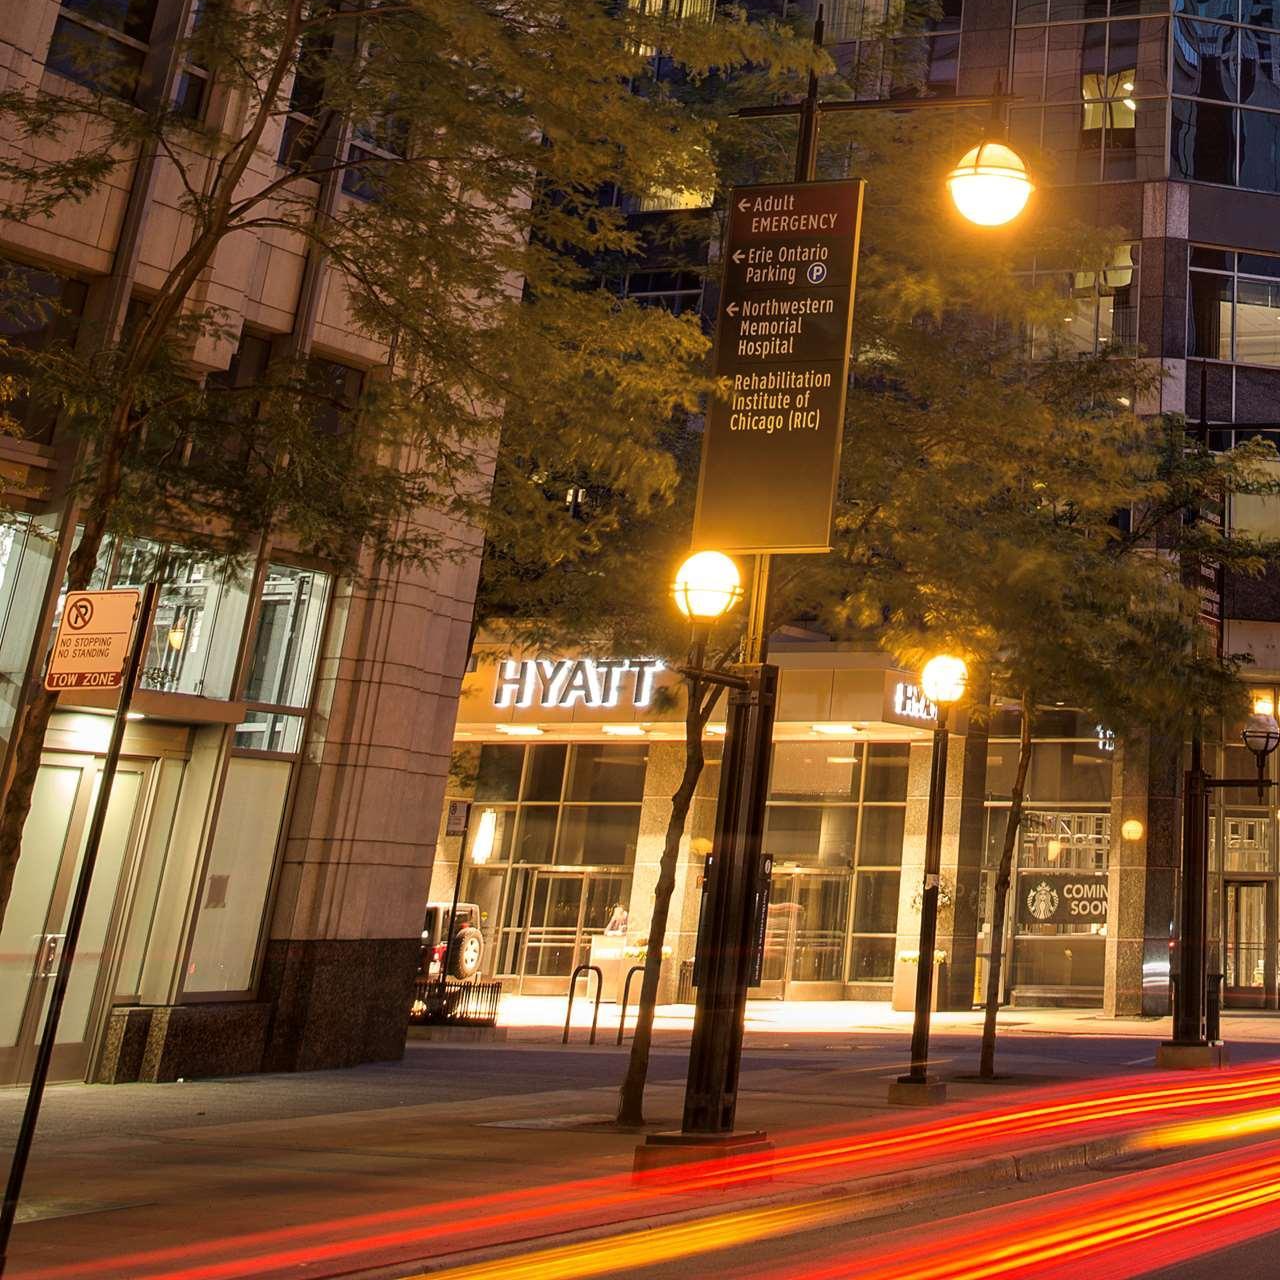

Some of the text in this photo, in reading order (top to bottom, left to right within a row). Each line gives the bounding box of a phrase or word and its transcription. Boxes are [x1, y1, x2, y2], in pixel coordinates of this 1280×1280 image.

[753, 195, 795, 213] Adult
[751, 213, 838, 233] EMERGENCY
[748, 243, 828, 264] Erie Ontario
[746, 264, 796, 285] Parking
[742, 297, 834, 317] Northwestern
[740, 317, 802, 336] Memorial
[738, 337, 794, 359] Hospital
[734, 370, 832, 391] Rehabilitation
[732, 390, 811, 411] Institute of
[730, 409, 820, 434] Chicago (RIC)
[60, 636, 112, 648] NO STOPPING
[57, 648, 110, 658] NO STANDING
[52, 672, 116, 687] TOW ZONE
[494, 659, 663, 707] HYATT
[1063, 883, 1109, 899] COMIN
